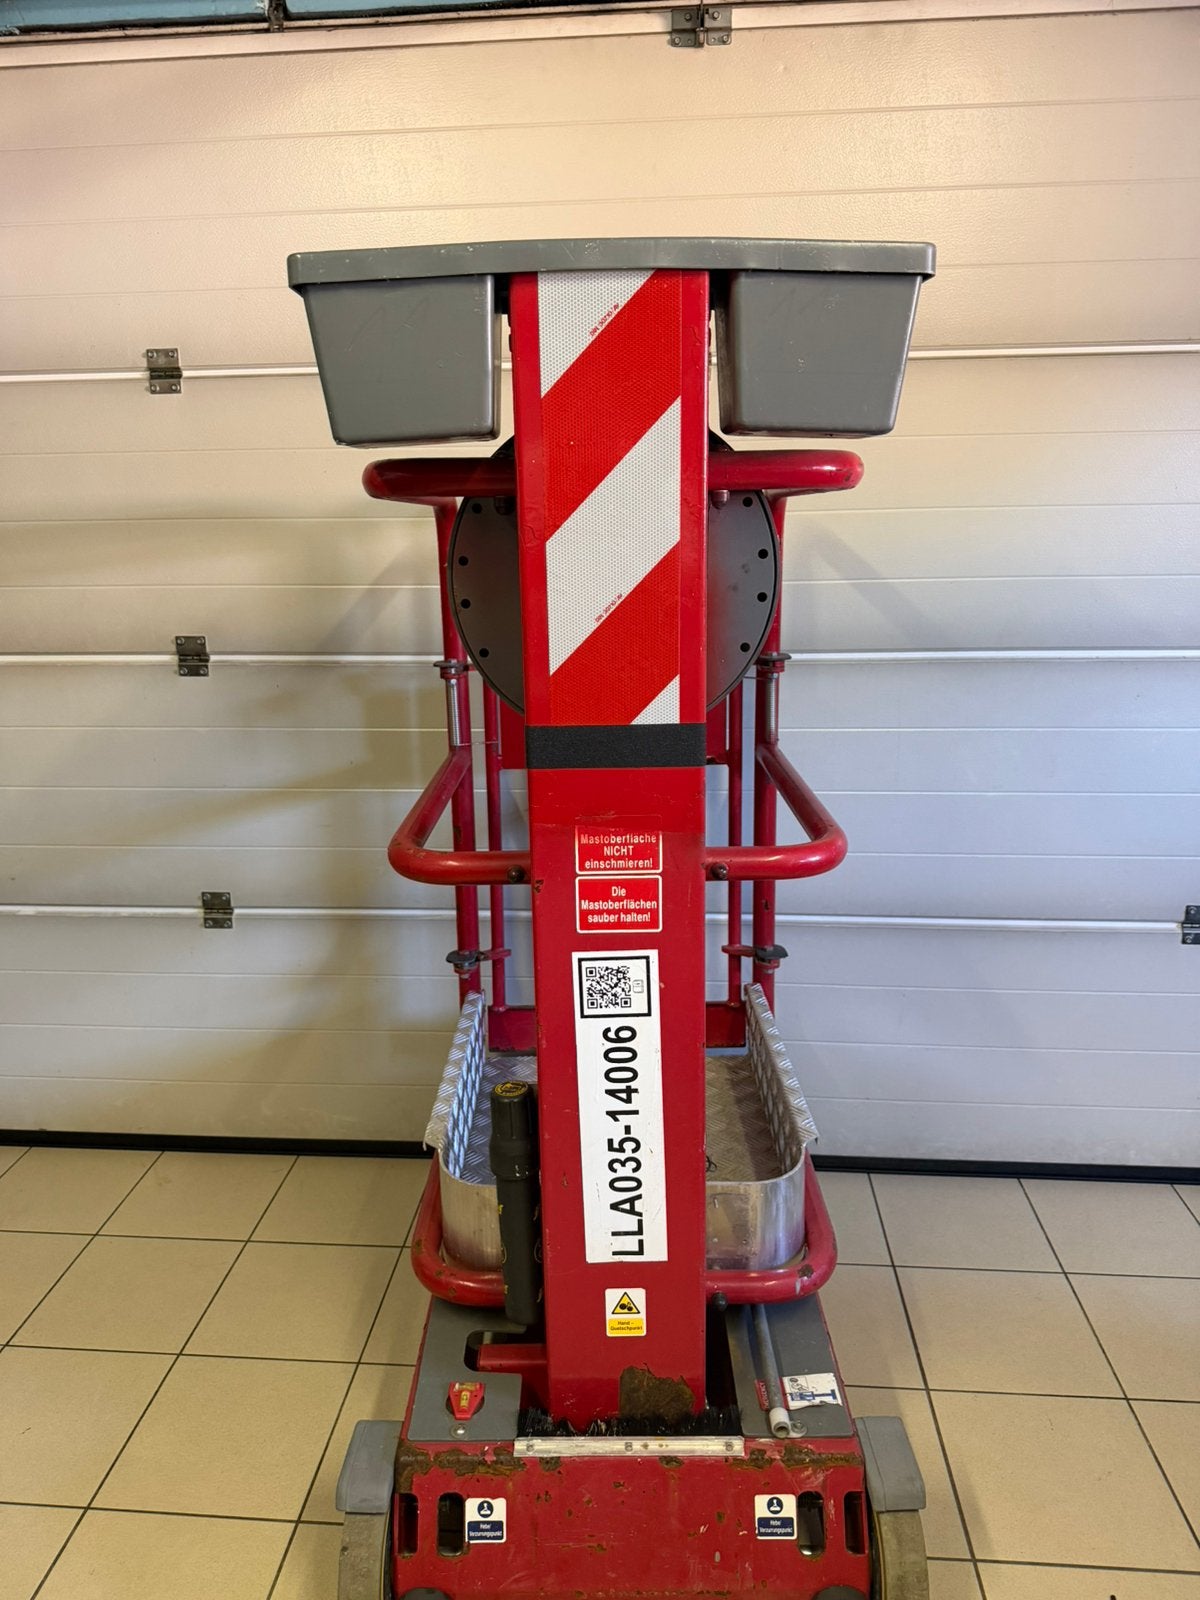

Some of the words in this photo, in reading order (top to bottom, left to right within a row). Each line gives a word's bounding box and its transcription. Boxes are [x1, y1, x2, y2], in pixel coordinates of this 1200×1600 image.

[603, 845, 634, 857] NICHT
[585, 857, 653, 869] einschmieren!
[611, 886, 627, 897] Die
[581, 899, 658, 910] Mastoberflächen
[587, 912, 619, 923] sauber
[620, 911, 651, 923] halten!
[602, 1025, 645, 1257] LLA035-14006
